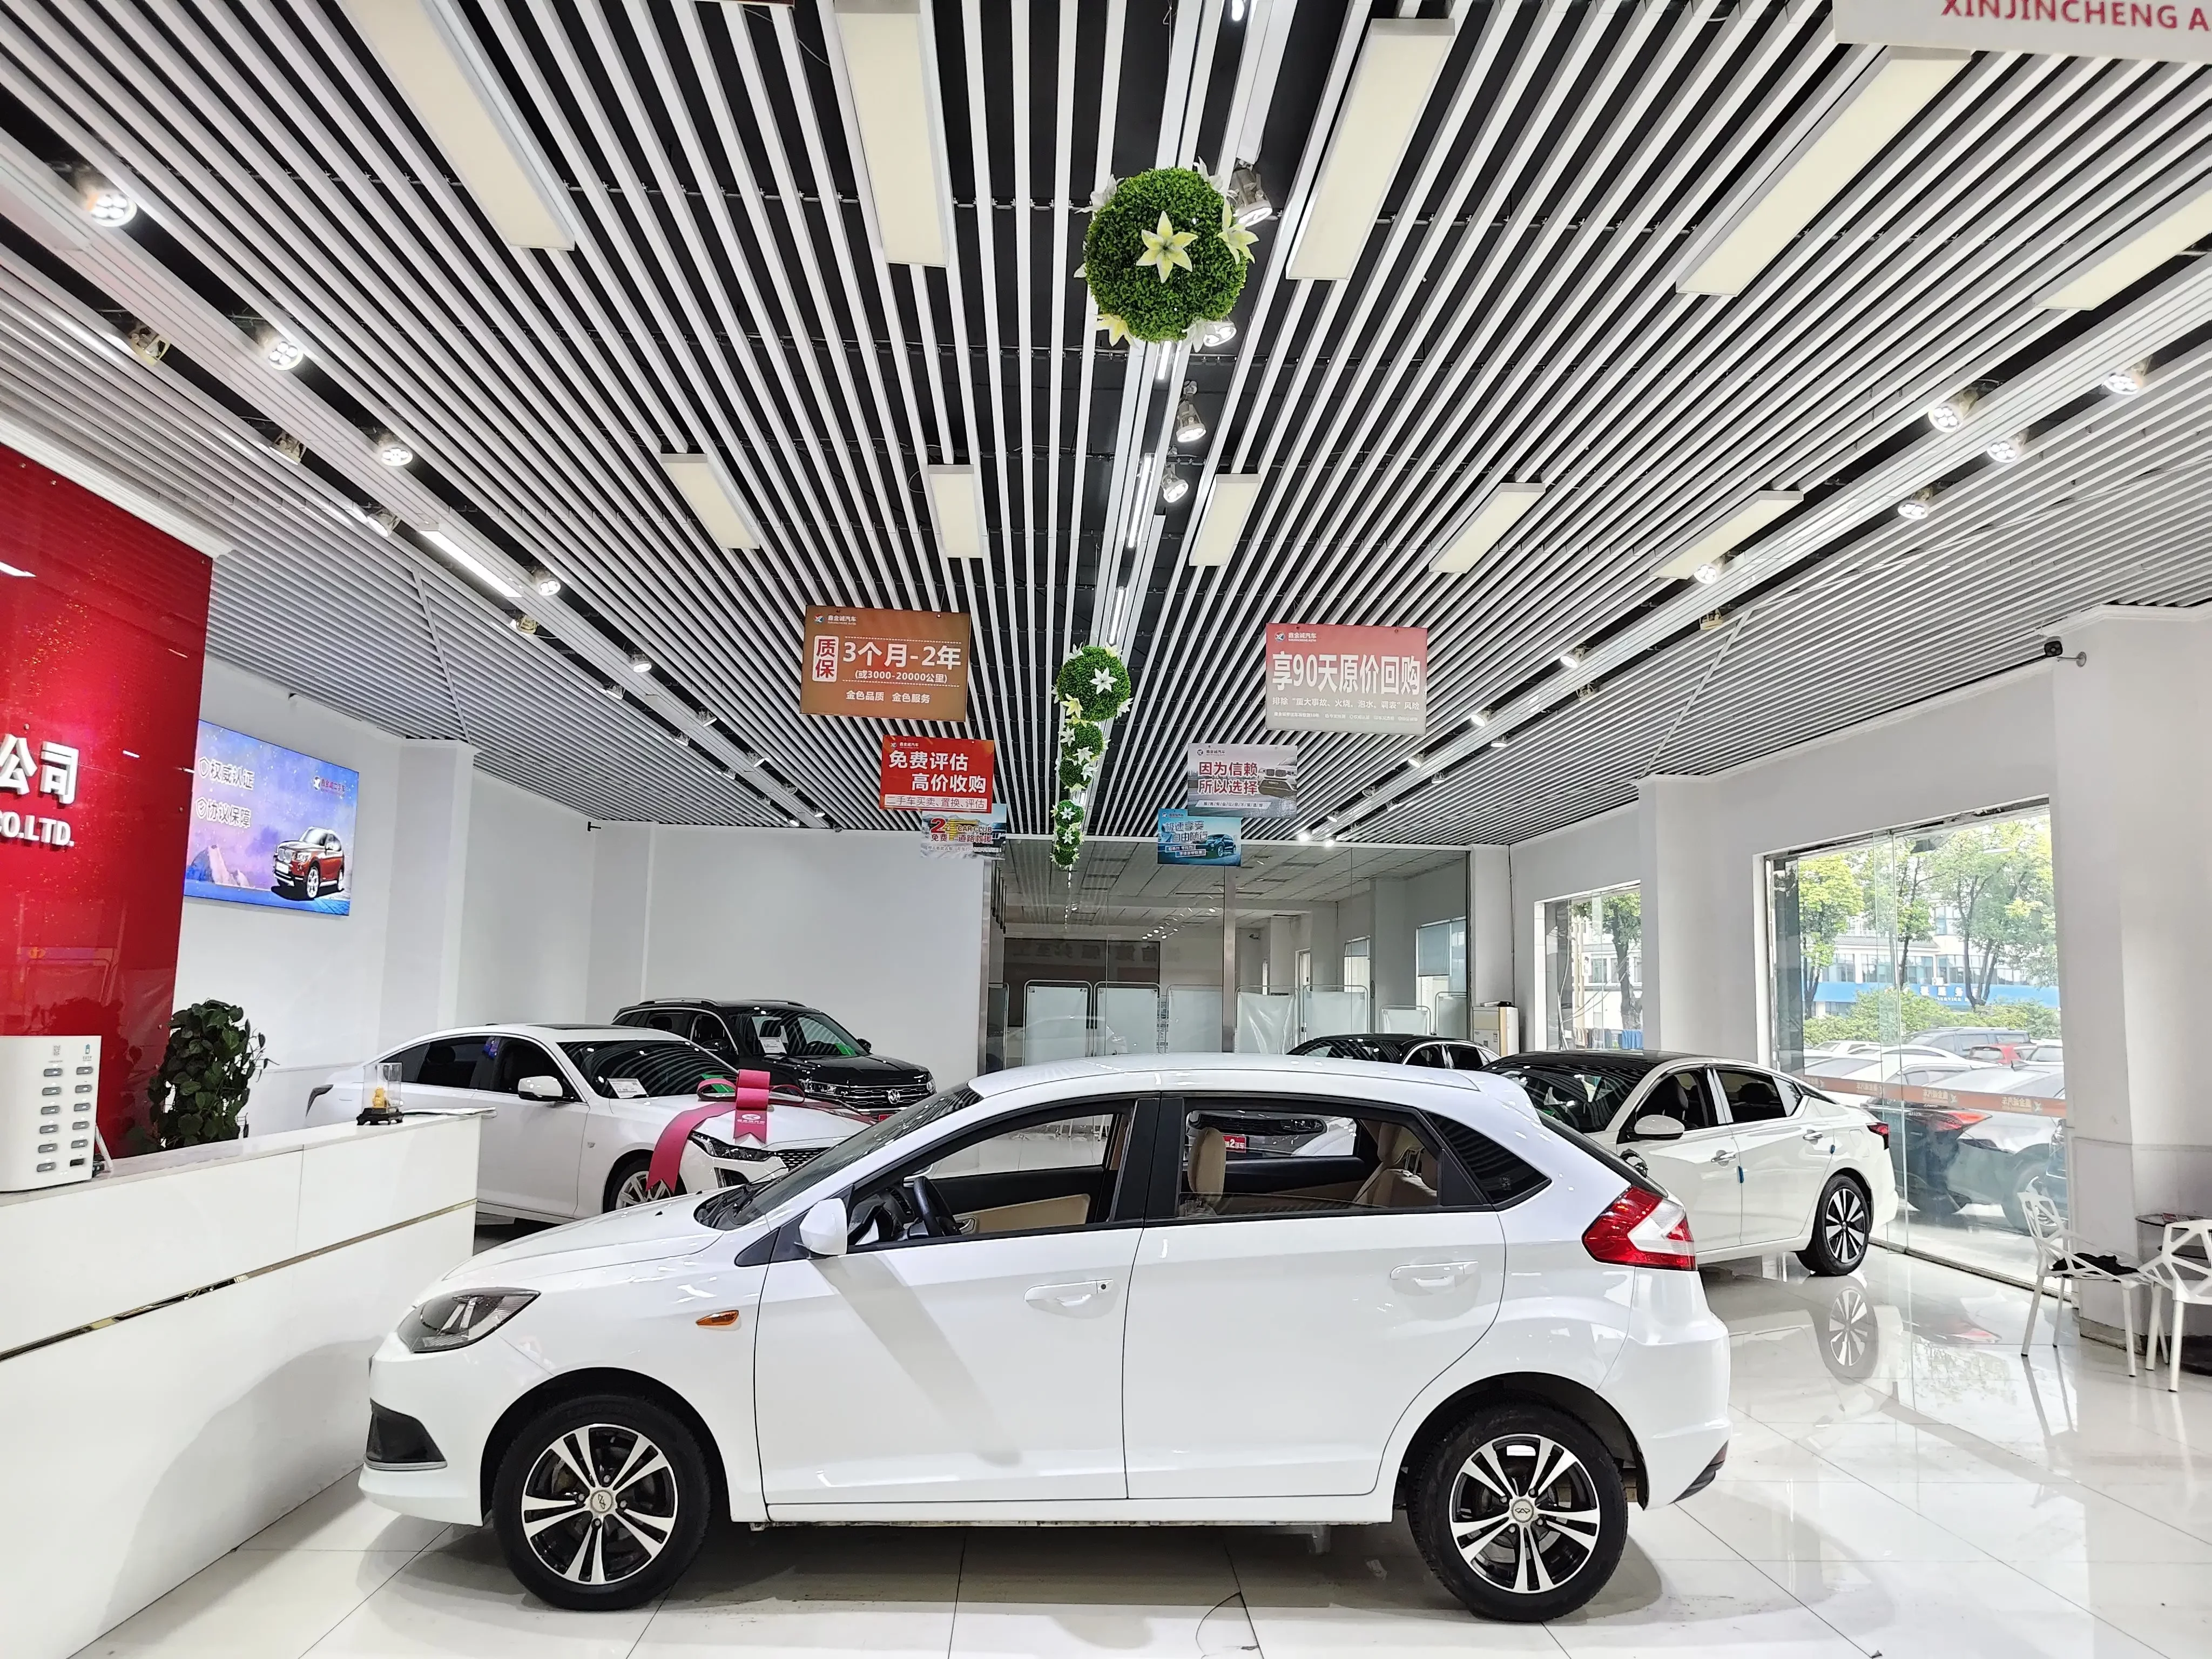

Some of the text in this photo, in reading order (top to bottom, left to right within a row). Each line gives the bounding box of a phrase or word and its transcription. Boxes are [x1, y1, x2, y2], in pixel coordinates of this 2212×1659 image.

[1941, 0, 2177, 29] XINJINCHENG
[815, 638, 836, 678] 质保
[842, 642, 961, 670] 3个月-2年
[1272, 651, 1421, 695] 享90天原价回购
[846, 690, 930, 704] 金色品质 金色服务
[0, 733, 79, 804] 公司
[888, 750, 968, 771] 免费评估
[1198, 761, 1258, 777] 因为信赖
[210, 760, 254, 790] 权威认证
[912, 773, 986, 793] 高价收购
[1198, 779, 1258, 795] 所以选择
[886, 795, 985, 808] 二手车买卖、置换、评估
[207, 800, 251, 828] 协议保障
[1164, 820, 1205, 832] 极速享受
[0, 810, 75, 847] O.LTD.
[931, 834, 992, 843] 免费 道路救援
